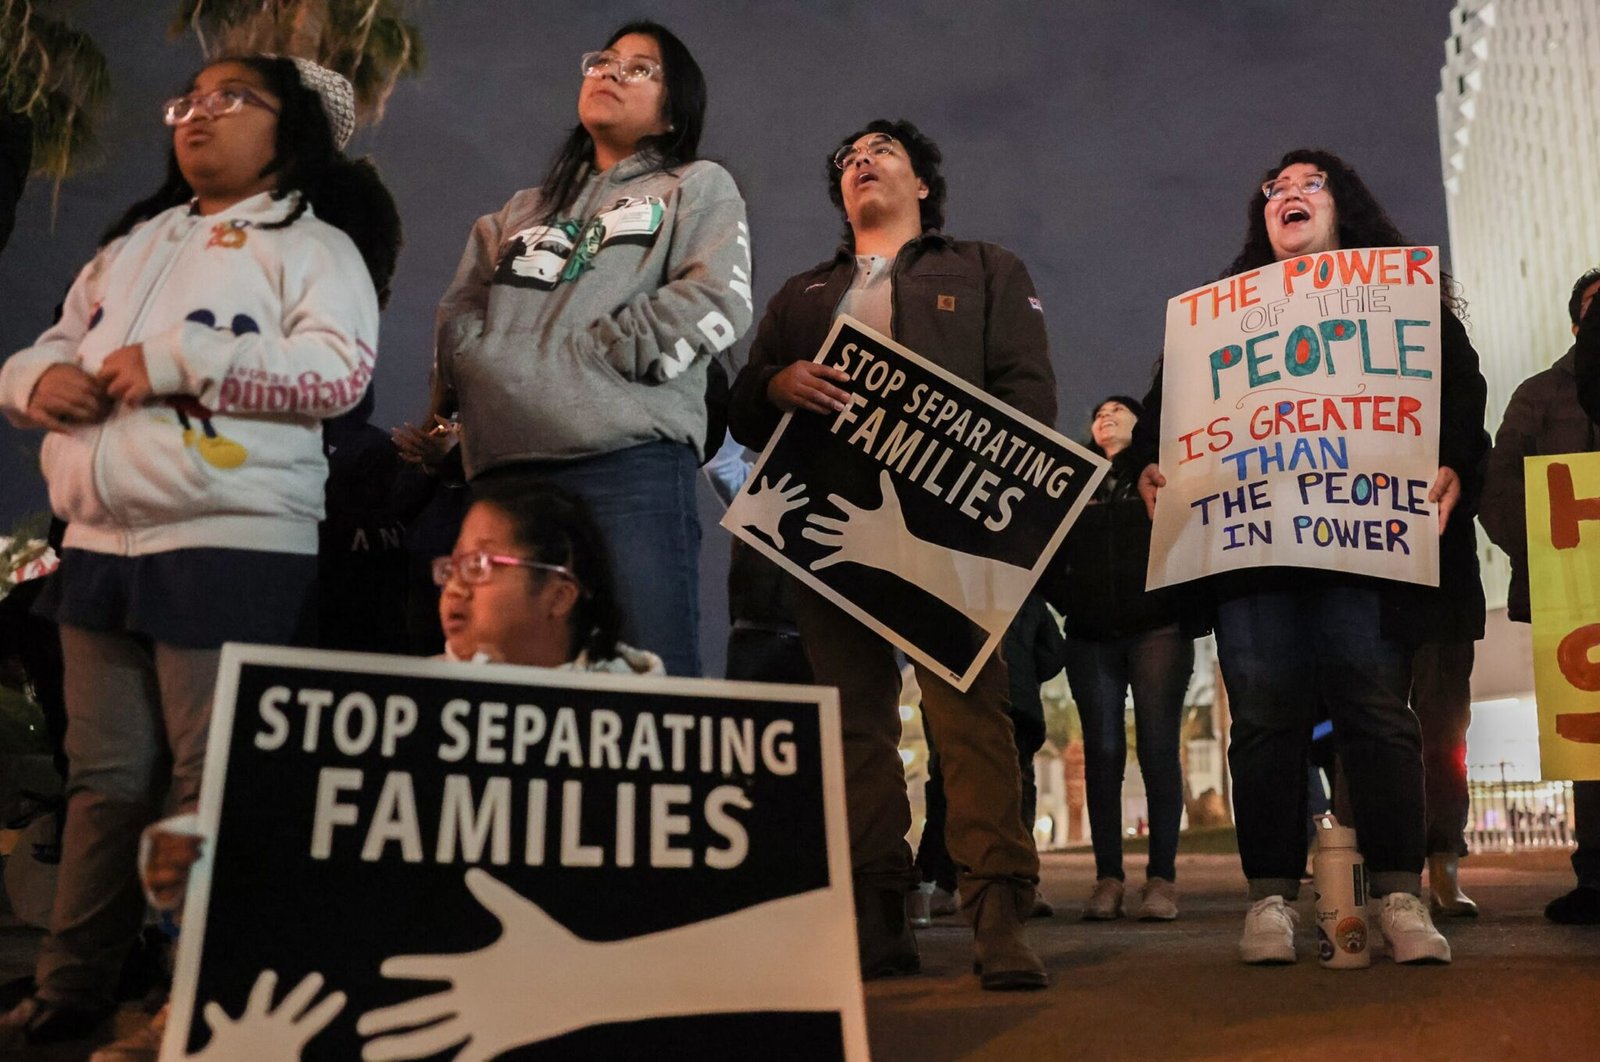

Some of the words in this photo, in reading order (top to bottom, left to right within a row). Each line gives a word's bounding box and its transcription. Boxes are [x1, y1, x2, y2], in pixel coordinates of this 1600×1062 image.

[1179, 271, 1261, 326] THE
[1283, 248, 1434, 297] POWER
[1240, 298, 1290, 333] OF
[1306, 285, 1391, 317] THE
[1209, 319, 1432, 401] PEOPLE
[833, 343, 906, 398] STOP
[903, 383, 1075, 499] SEPARATING
[1178, 416, 1234, 465] IS
[1249, 396, 1422, 441] GREATER
[1221, 436, 1349, 481] THAN
[830, 391, 1026, 533] FAMILIES
[1190, 480, 1272, 526] THE
[1297, 472, 1430, 516] PEOPLE
[1222, 520, 1273, 551] IN
[1292, 515, 1410, 555] POWER
[254, 685, 419, 757] STOP
[437, 699, 798, 777] SEPARATING
[309, 767, 754, 870] FAMILIES
